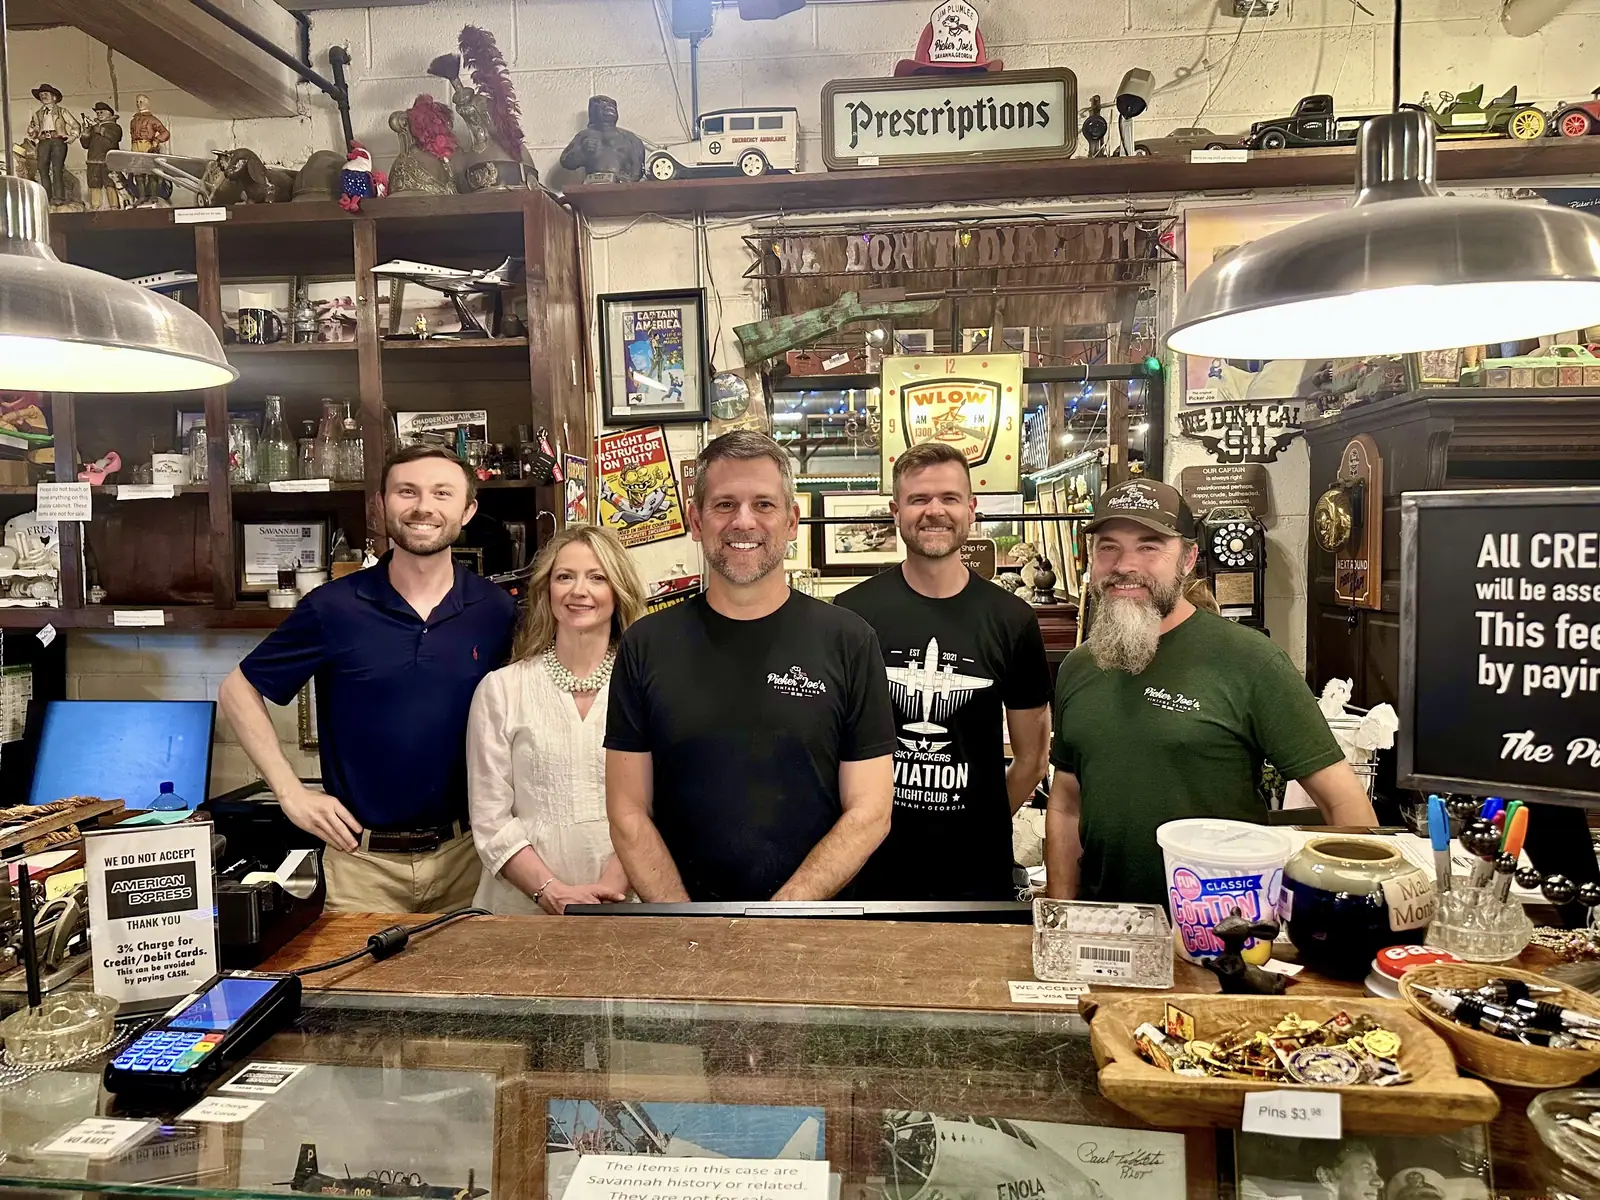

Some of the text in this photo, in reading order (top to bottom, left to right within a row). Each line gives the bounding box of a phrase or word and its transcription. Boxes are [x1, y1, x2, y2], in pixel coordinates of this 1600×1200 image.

[937, 5, 974, 21] JIM PLUMLEE
[844, 97, 1051, 149] Prescriptions
[780, 236, 820, 273] WE
[1083, 221, 1136, 260] 911
[635, 309, 682, 332] CAPTAIN AMERICA
[944, 358, 956, 374] 12
[913, 390, 988, 406] WLOW
[412, 415, 455, 426] CHADDERTON
[888, 419, 896, 434] 9
[915, 414, 985, 425] AM FM
[1005, 416, 1013, 431] 3
[1177, 405, 1306, 434] WE DON'T CAL
[915, 427, 933, 438] 1300
[604, 433, 643, 451] FLIGHT
[962, 444, 979, 457] ADIO
[603, 451, 653, 471] ON DUTY
[1218, 466, 1246, 474] CAPTAIN
[259, 527, 299, 535] SAVANNAH
[976, 544, 987, 552] for
[1476, 533, 1600, 569] All CRE
[1475, 577, 1514, 600] will
[1519, 577, 1546, 602] be
[1475, 611, 1545, 649] This
[909, 649, 957, 661] EST 2021
[767, 672, 826, 693] Picker Joe's
[1478, 653, 1515, 695] by
[1143, 686, 1171, 701] Picker
[1172, 693, 1200, 711] Joe's
[1500, 729, 1554, 763] The
[894, 750, 952, 762] SKY PICKERS
[893, 761, 969, 790] VIATION
[893, 786, 948, 803] FLIGHT CLUB
[927, 803, 967, 812] GEORGIA
[104, 848, 196, 867] WE DO NOT ACCEPT
[111, 874, 186, 894] AMERICAN
[1178, 875, 1198, 889] FUN
[1205, 879, 1254, 891] CLASSIC
[128, 887, 192, 906] EXPRESS
[126, 914, 181, 931] THANK YOU
[117, 936, 194, 954] 3% Charge for
[103, 946, 208, 969] Credit/Debit Cards.
[117, 967, 133, 977] This
[135, 966, 149, 974] can
[164, 958, 196, 969] avoided
[124, 969, 190, 985] by paying CASH.
[1036, 984, 1085, 992] ACCEPT
[1258, 1105, 1322, 1122] Pins $3.98
[63, 1135, 113, 1145] NO AMEX
[307, 1149, 314, 1161] P
[1076, 1141, 1115, 1164] Paul
[606, 1161, 799, 1176] The items in this case are
[587, 1175, 807, 1191] Savannah history or related.
[996, 1177, 1046, 1200] ENOLA
[609, 1191, 646, 1200] They
